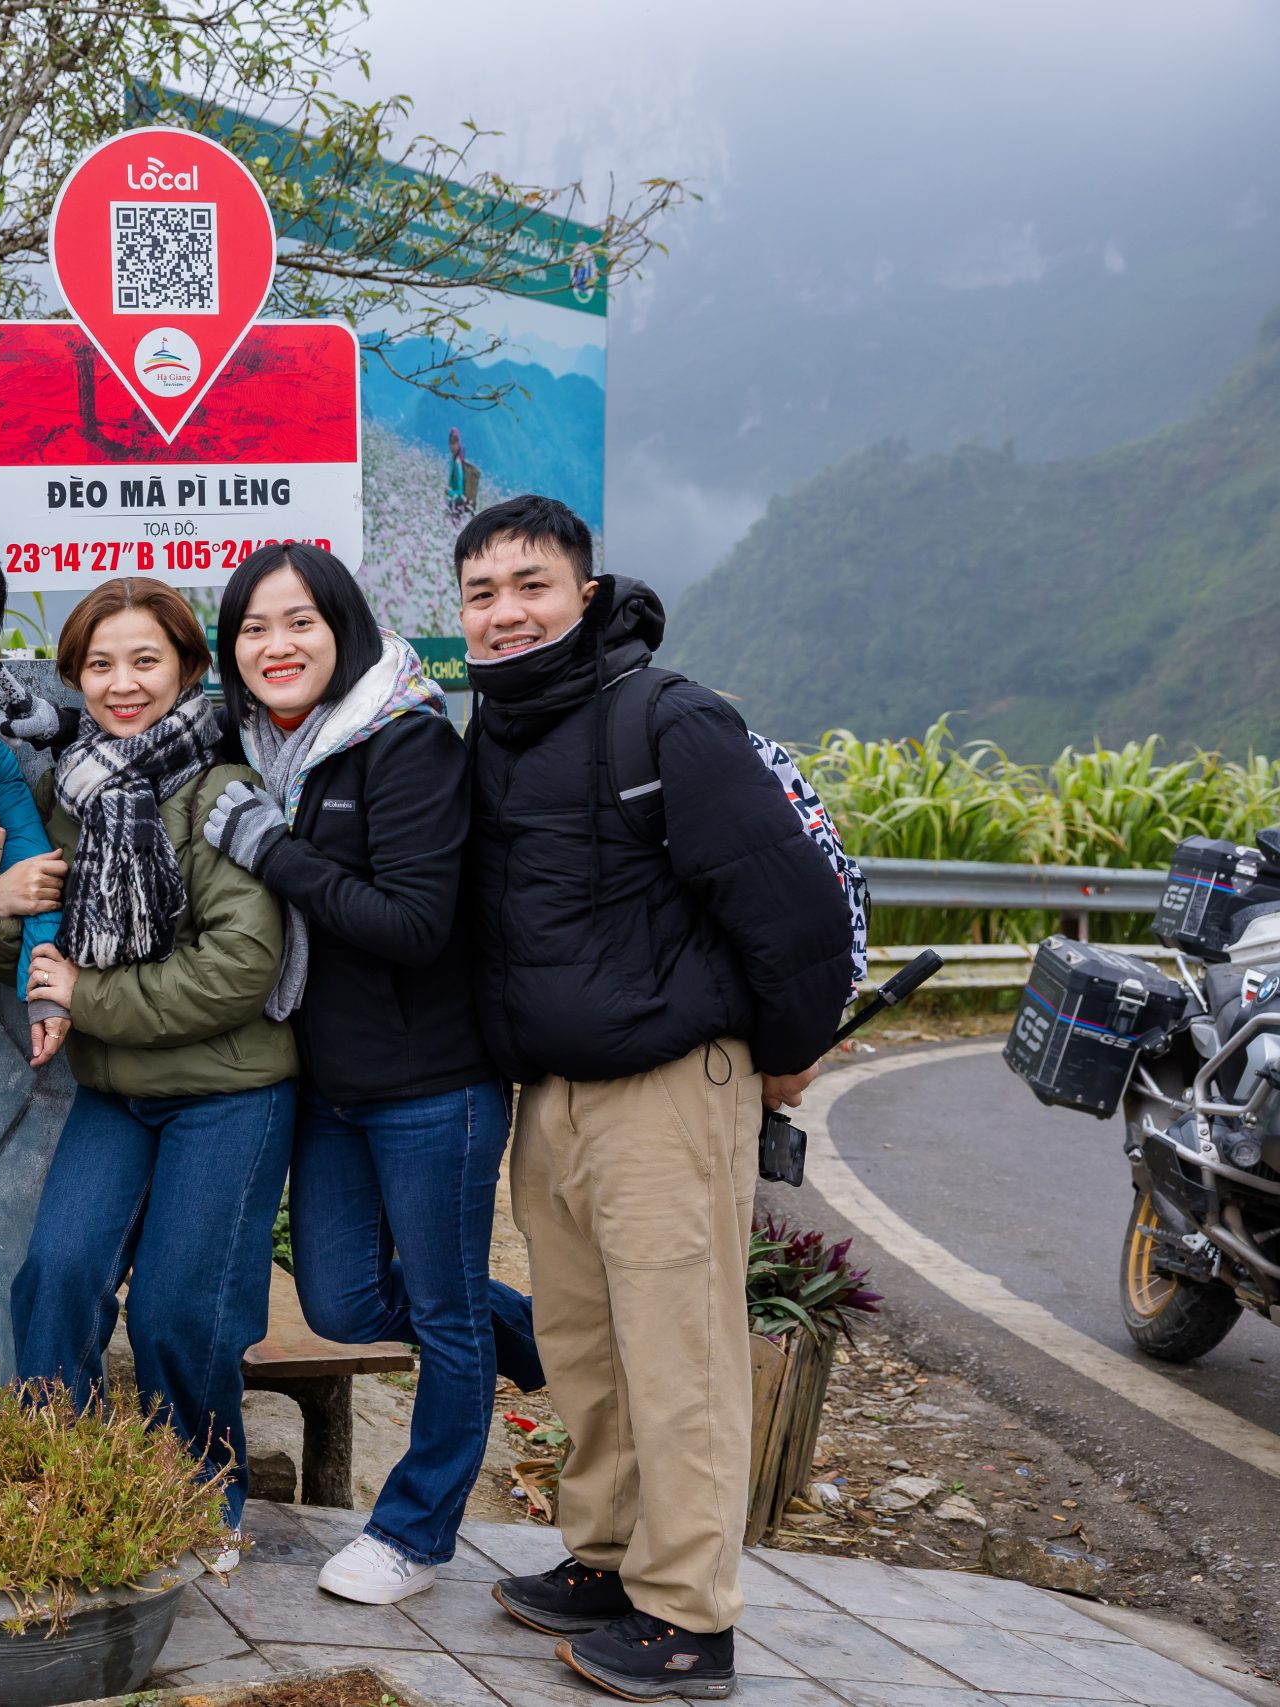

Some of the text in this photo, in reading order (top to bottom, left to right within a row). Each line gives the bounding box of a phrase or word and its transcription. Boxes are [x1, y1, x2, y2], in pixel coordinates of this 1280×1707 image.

[127, 163, 198, 191] Local
[169, 373, 192, 382] Giang
[47, 473, 290, 509] ĐÈO MÃ PÌ LÈNG
[144, 520, 198, 538] TỌA ĐỘ:
[432, 657, 464, 679] CHỨC
[328, 800, 353, 809] Columbia
[1015, 1005, 1050, 1052] GS
